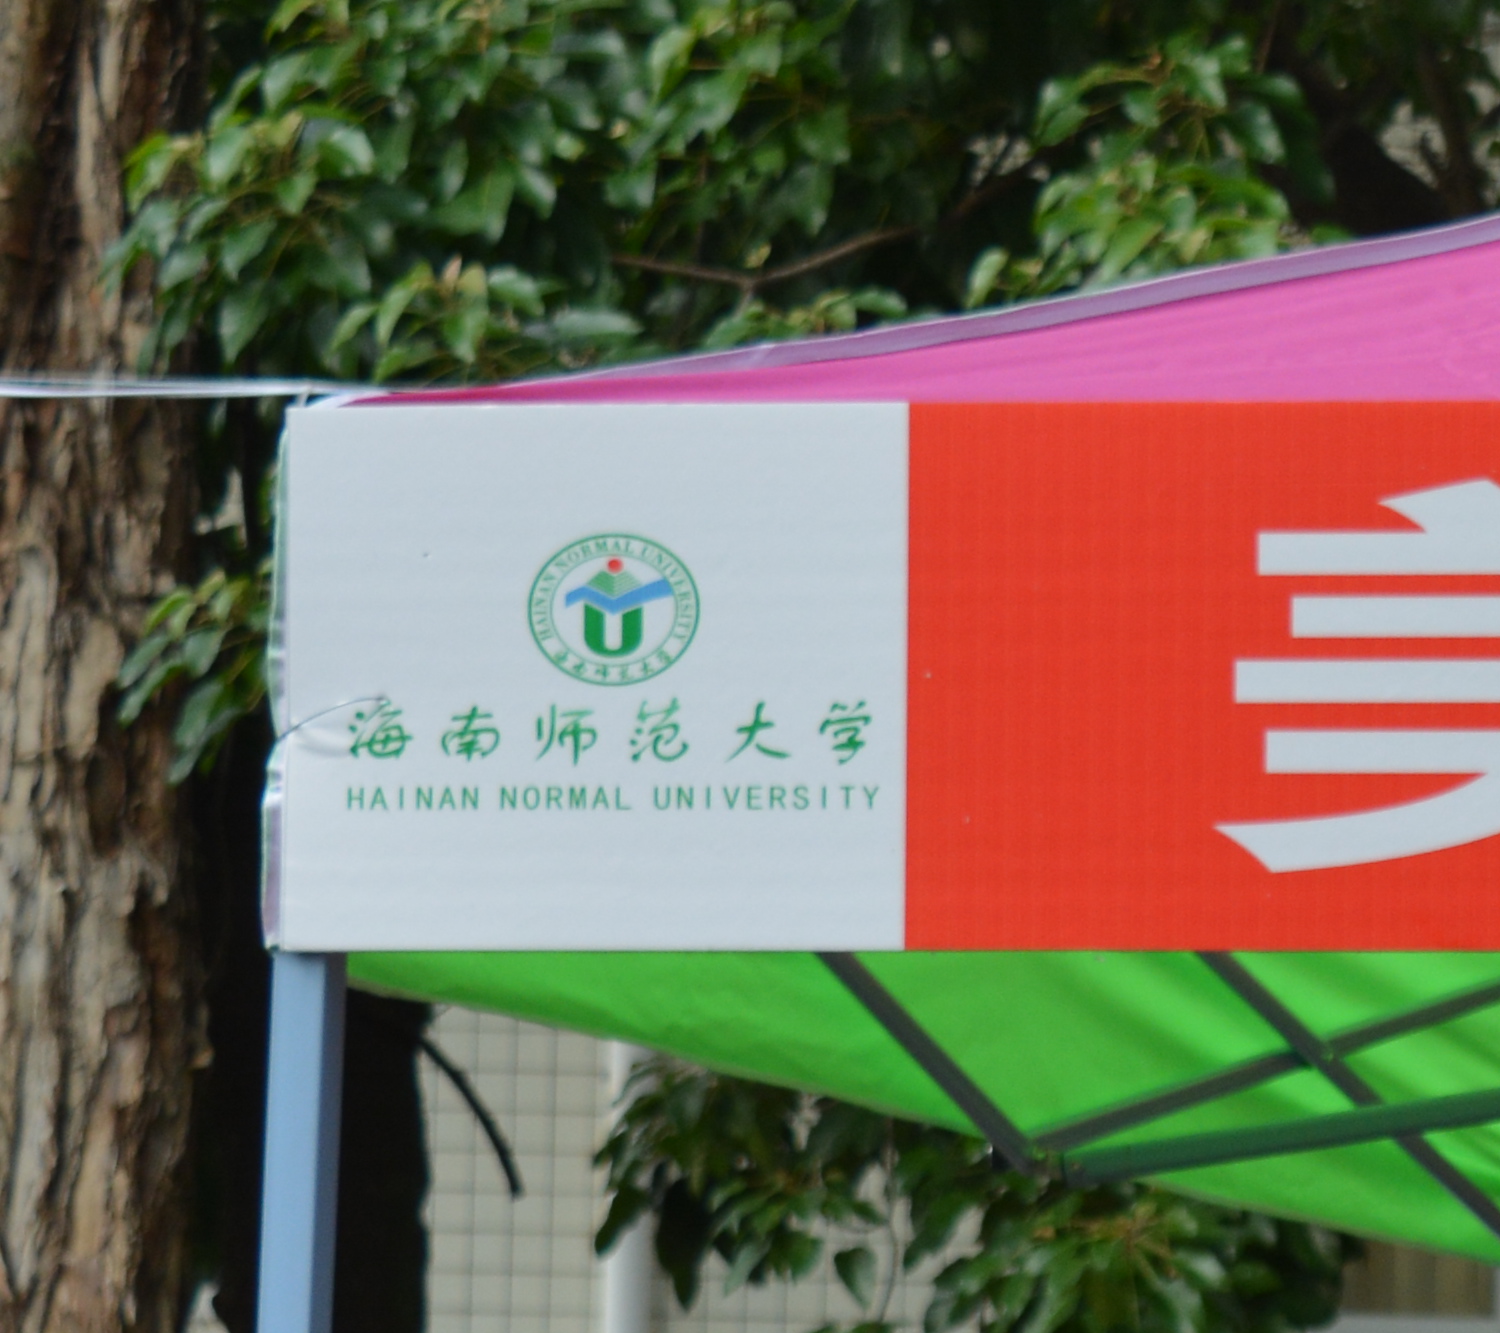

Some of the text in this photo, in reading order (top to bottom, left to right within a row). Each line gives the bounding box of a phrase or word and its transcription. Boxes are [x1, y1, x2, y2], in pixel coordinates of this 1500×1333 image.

[346, 697, 873, 766] 海南师范大学
[346, 785, 881, 811] HAINAN NORMAL UNIVERSITY
